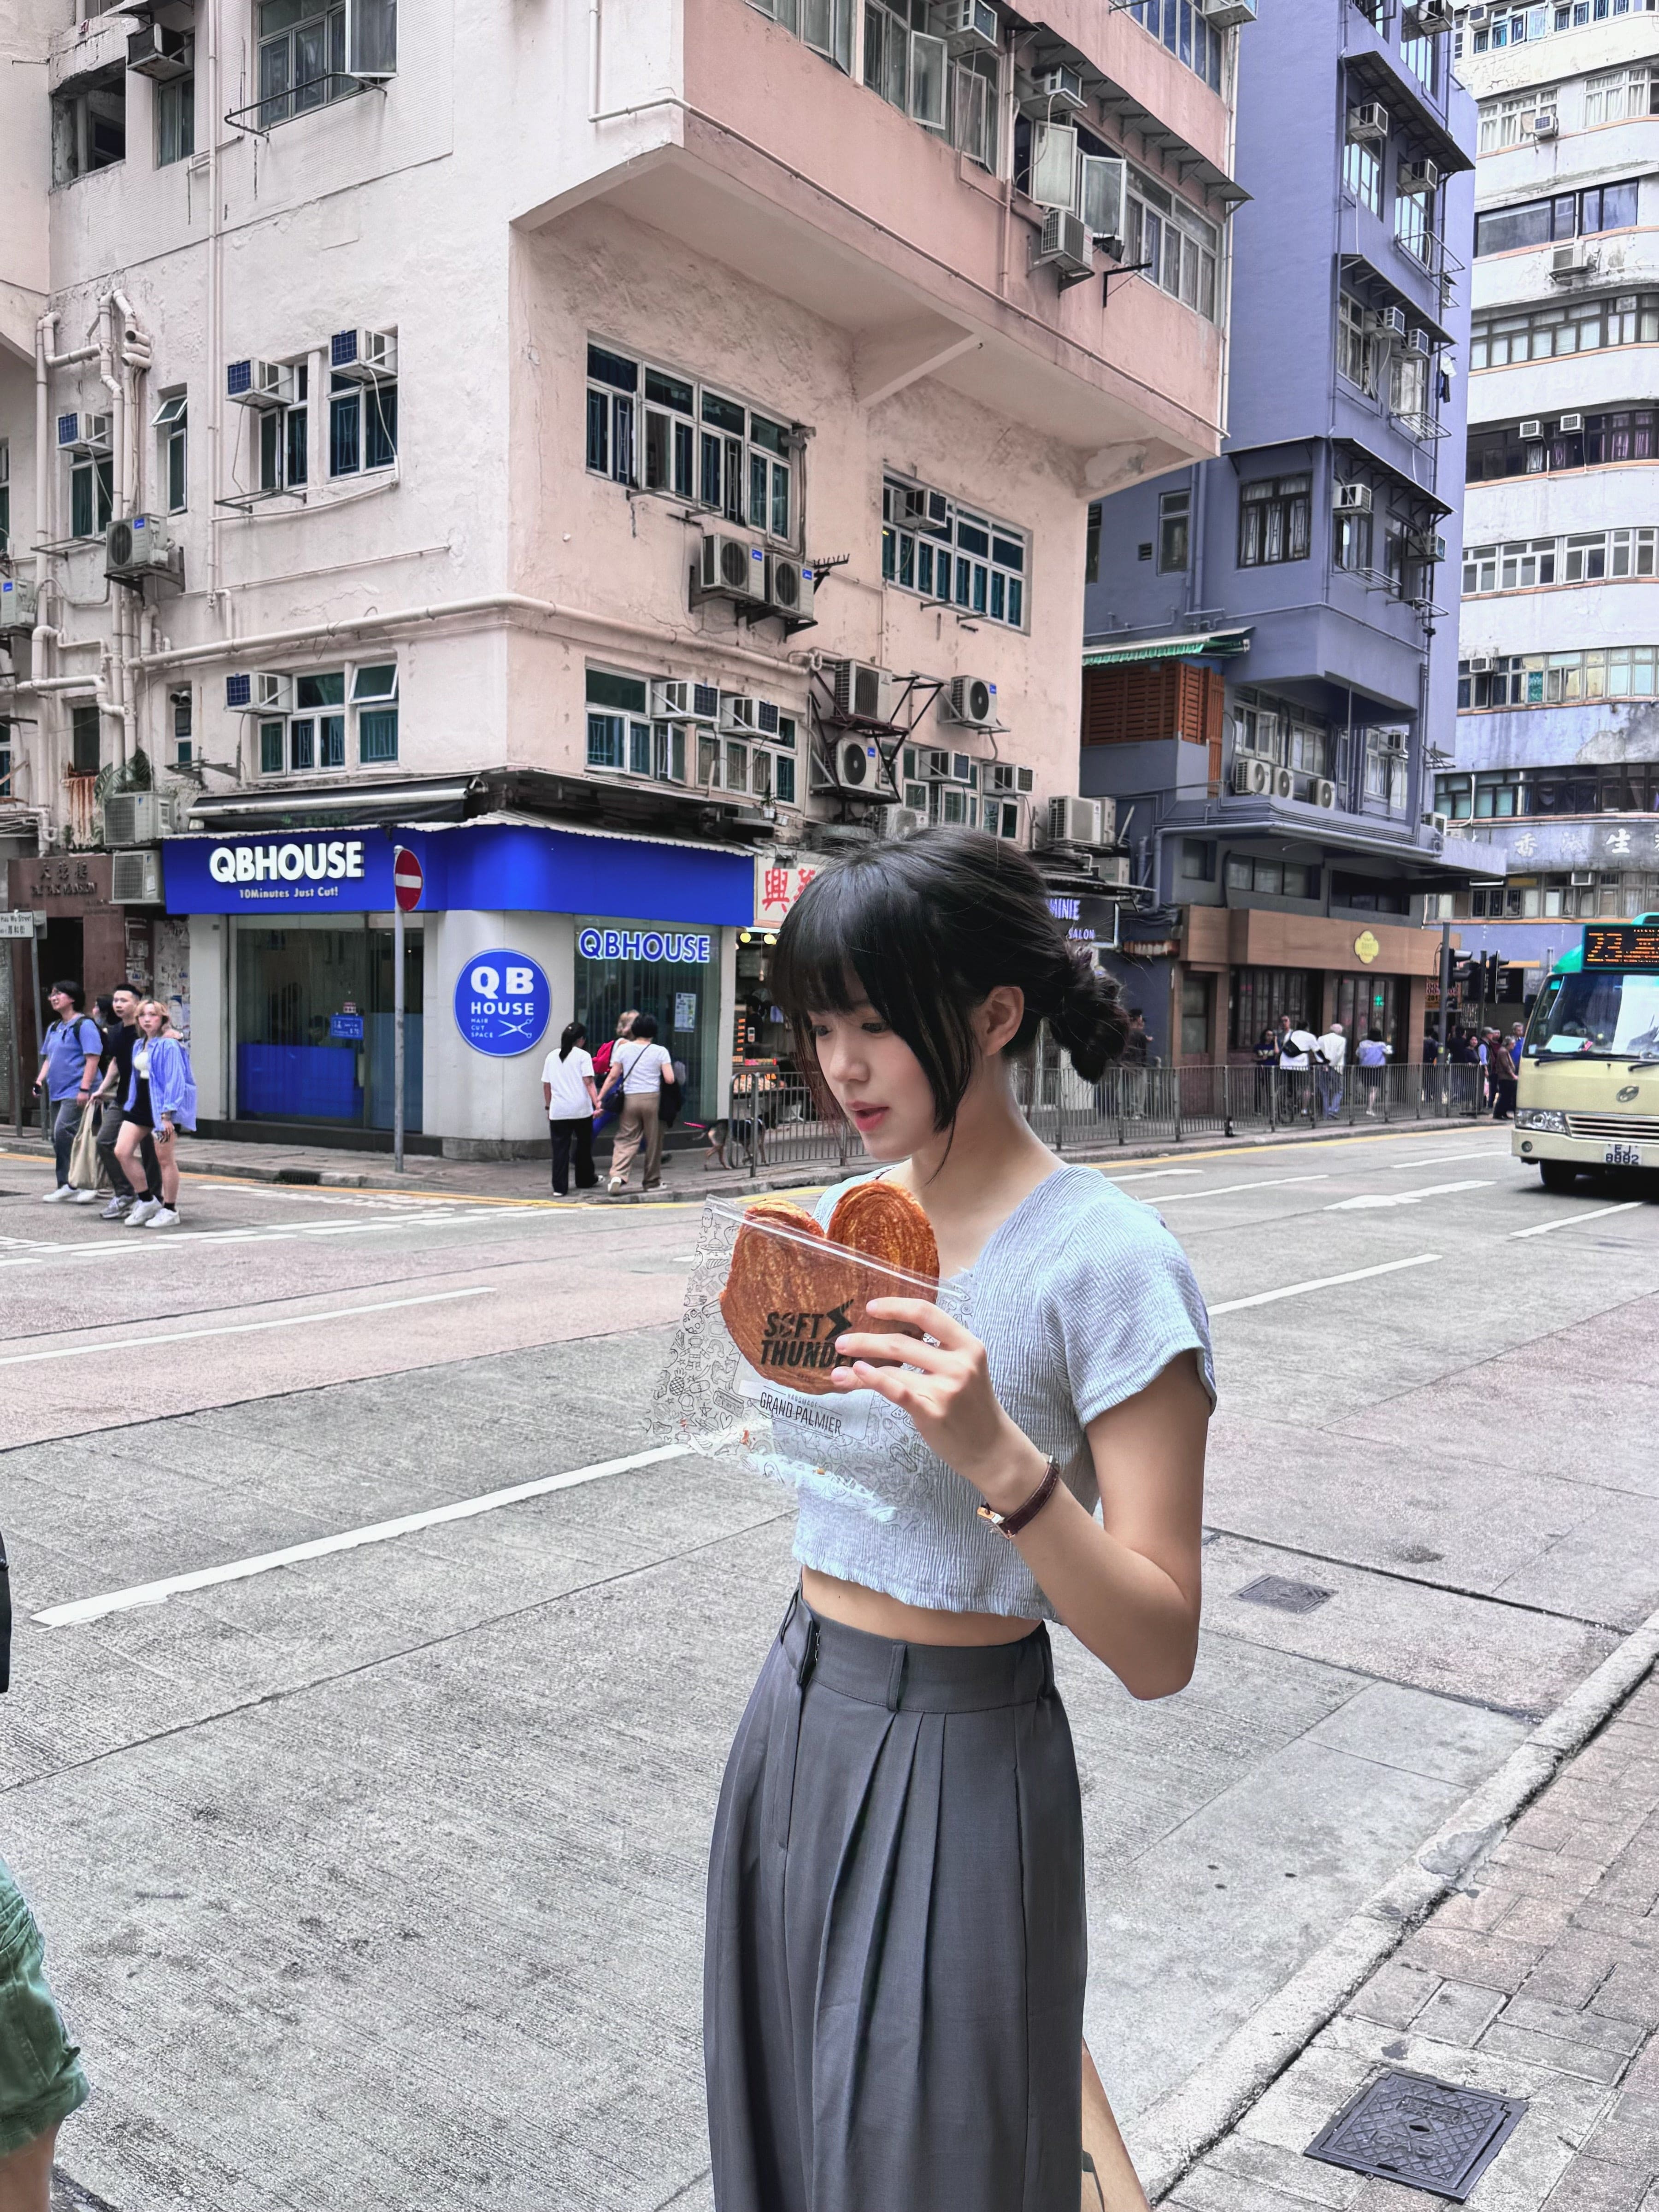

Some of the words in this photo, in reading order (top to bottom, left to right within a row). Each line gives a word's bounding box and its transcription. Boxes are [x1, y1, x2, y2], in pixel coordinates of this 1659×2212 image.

[209, 841, 365, 883] QBHOUSE
[239, 888, 289, 899] 10Minutes
[294, 888, 314, 897] Just
[318, 886, 338, 897] Cut!
[579, 928, 710, 963] QBHOUSE
[1068, 929, 1095, 940] SALON
[471, 1001, 534, 1015] HOUSE
[760, 1392, 793, 1418] GRAND
[796, 1405, 841, 1435] PALMIER
